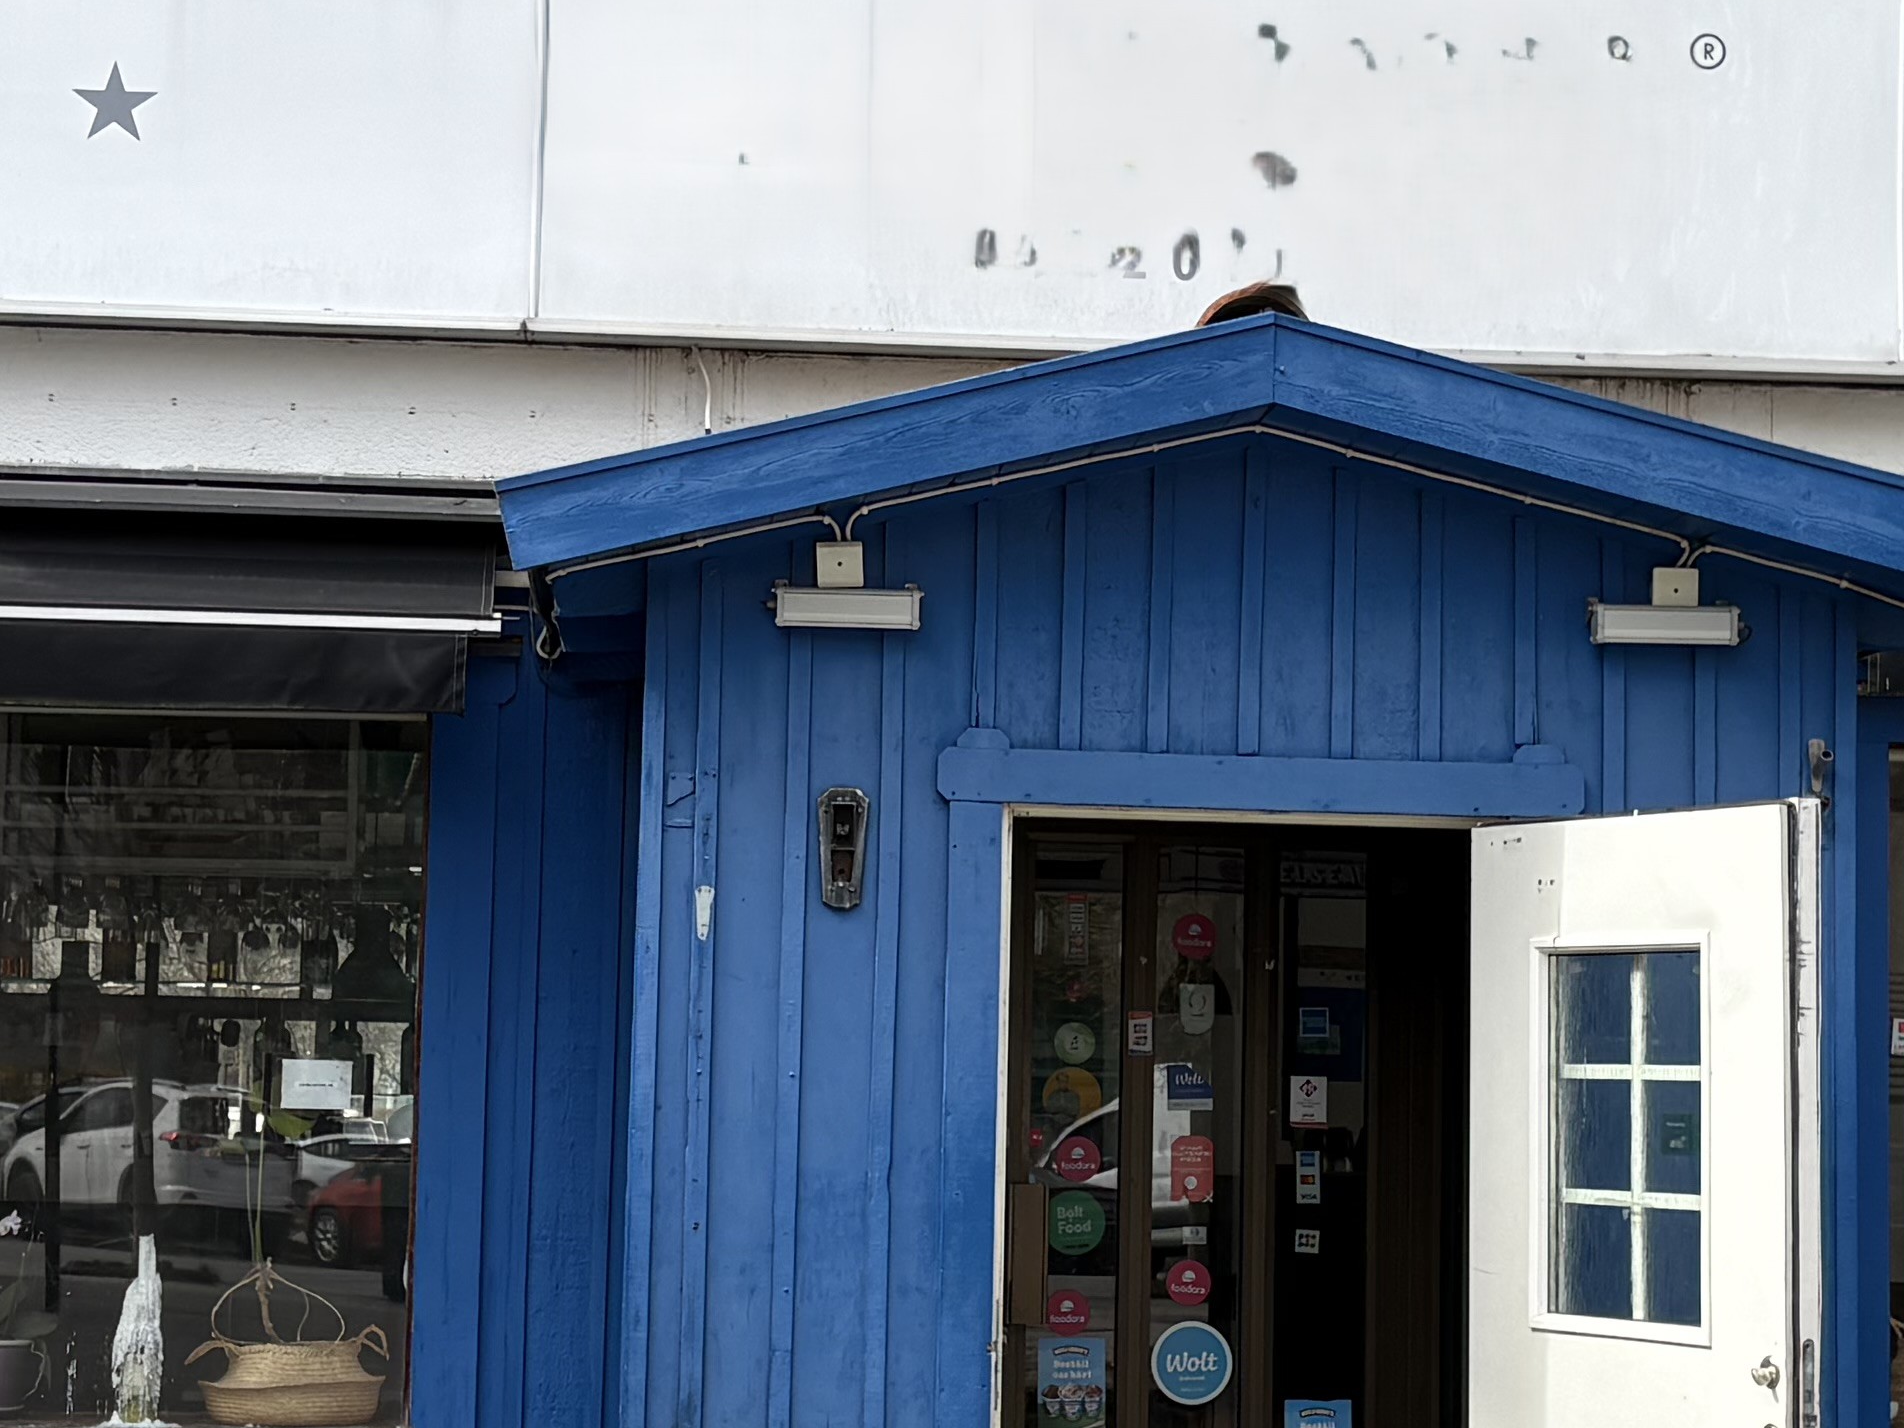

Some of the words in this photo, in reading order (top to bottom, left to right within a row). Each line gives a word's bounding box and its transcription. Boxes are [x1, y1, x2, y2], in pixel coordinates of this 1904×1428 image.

[1056, 1204, 1083, 1219] Bolt
[1057, 1219, 1092, 1234] Food
[1166, 1351, 1218, 1373] Wolt
